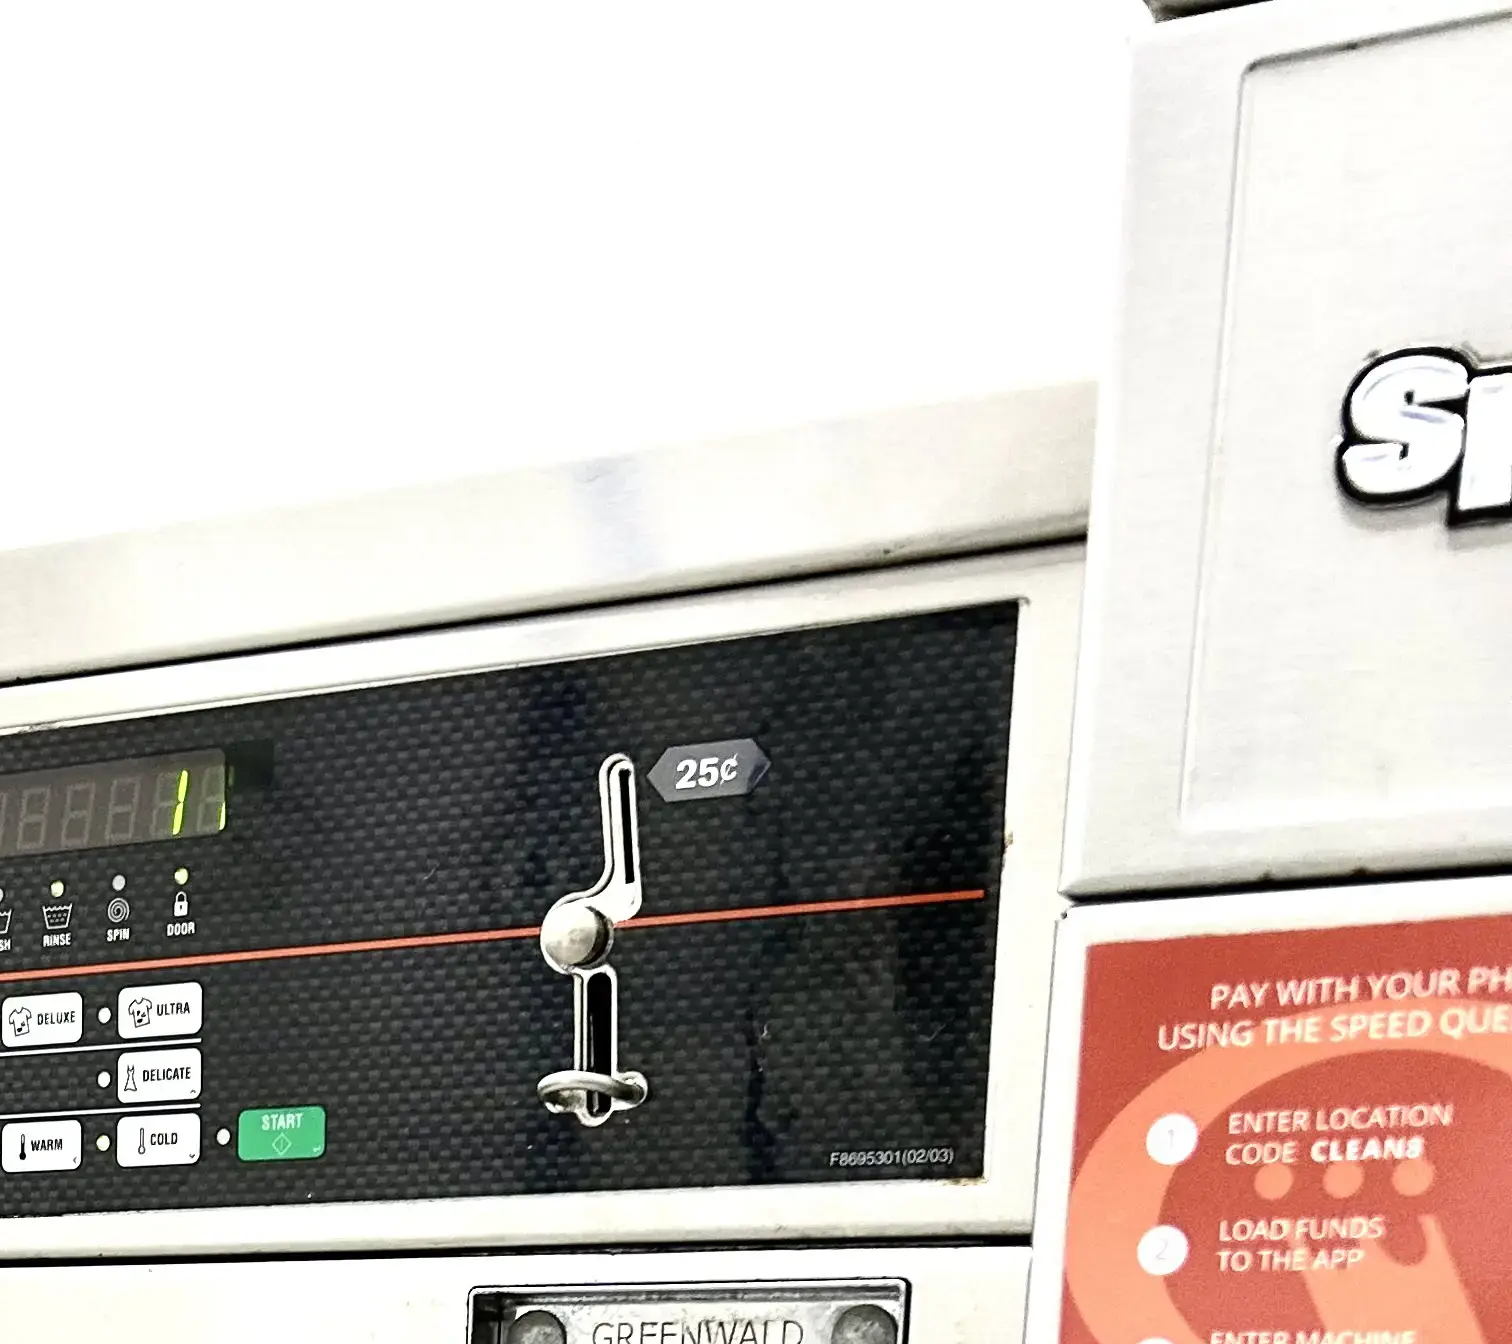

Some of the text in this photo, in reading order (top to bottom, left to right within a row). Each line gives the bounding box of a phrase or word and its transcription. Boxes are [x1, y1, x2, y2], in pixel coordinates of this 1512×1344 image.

[675, 752, 739, 790] 25¢
[43, 934, 71, 947] RINSE
[106, 928, 130, 942] SPIN
[166, 922, 196, 936] DOOR
[1210, 982, 1271, 1010] PAY
[1276, 975, 1360, 1006] WITH
[1367, 968, 1461, 1000] YOUR
[36, 1011, 76, 1027] DELUXE
[156, 1002, 191, 1017] ULTRA
[1158, 1019, 1255, 1051] USING
[1263, 1015, 1322, 1045] THE
[1330, 1010, 1433, 1043] SPEED
[142, 1067, 192, 1082] DELICATE
[261, 1113, 303, 1131] START
[1228, 1103, 1455, 1135] ENTER LOCATION
[30, 1138, 64, 1152] WARM
[149, 1132, 179, 1146] COLD
[1225, 1135, 1425, 1165] CODE CLEAN8
[1218, 1215, 1387, 1242] LOAD FUNDS
[1216, 1248, 1365, 1272] TO THE APP
